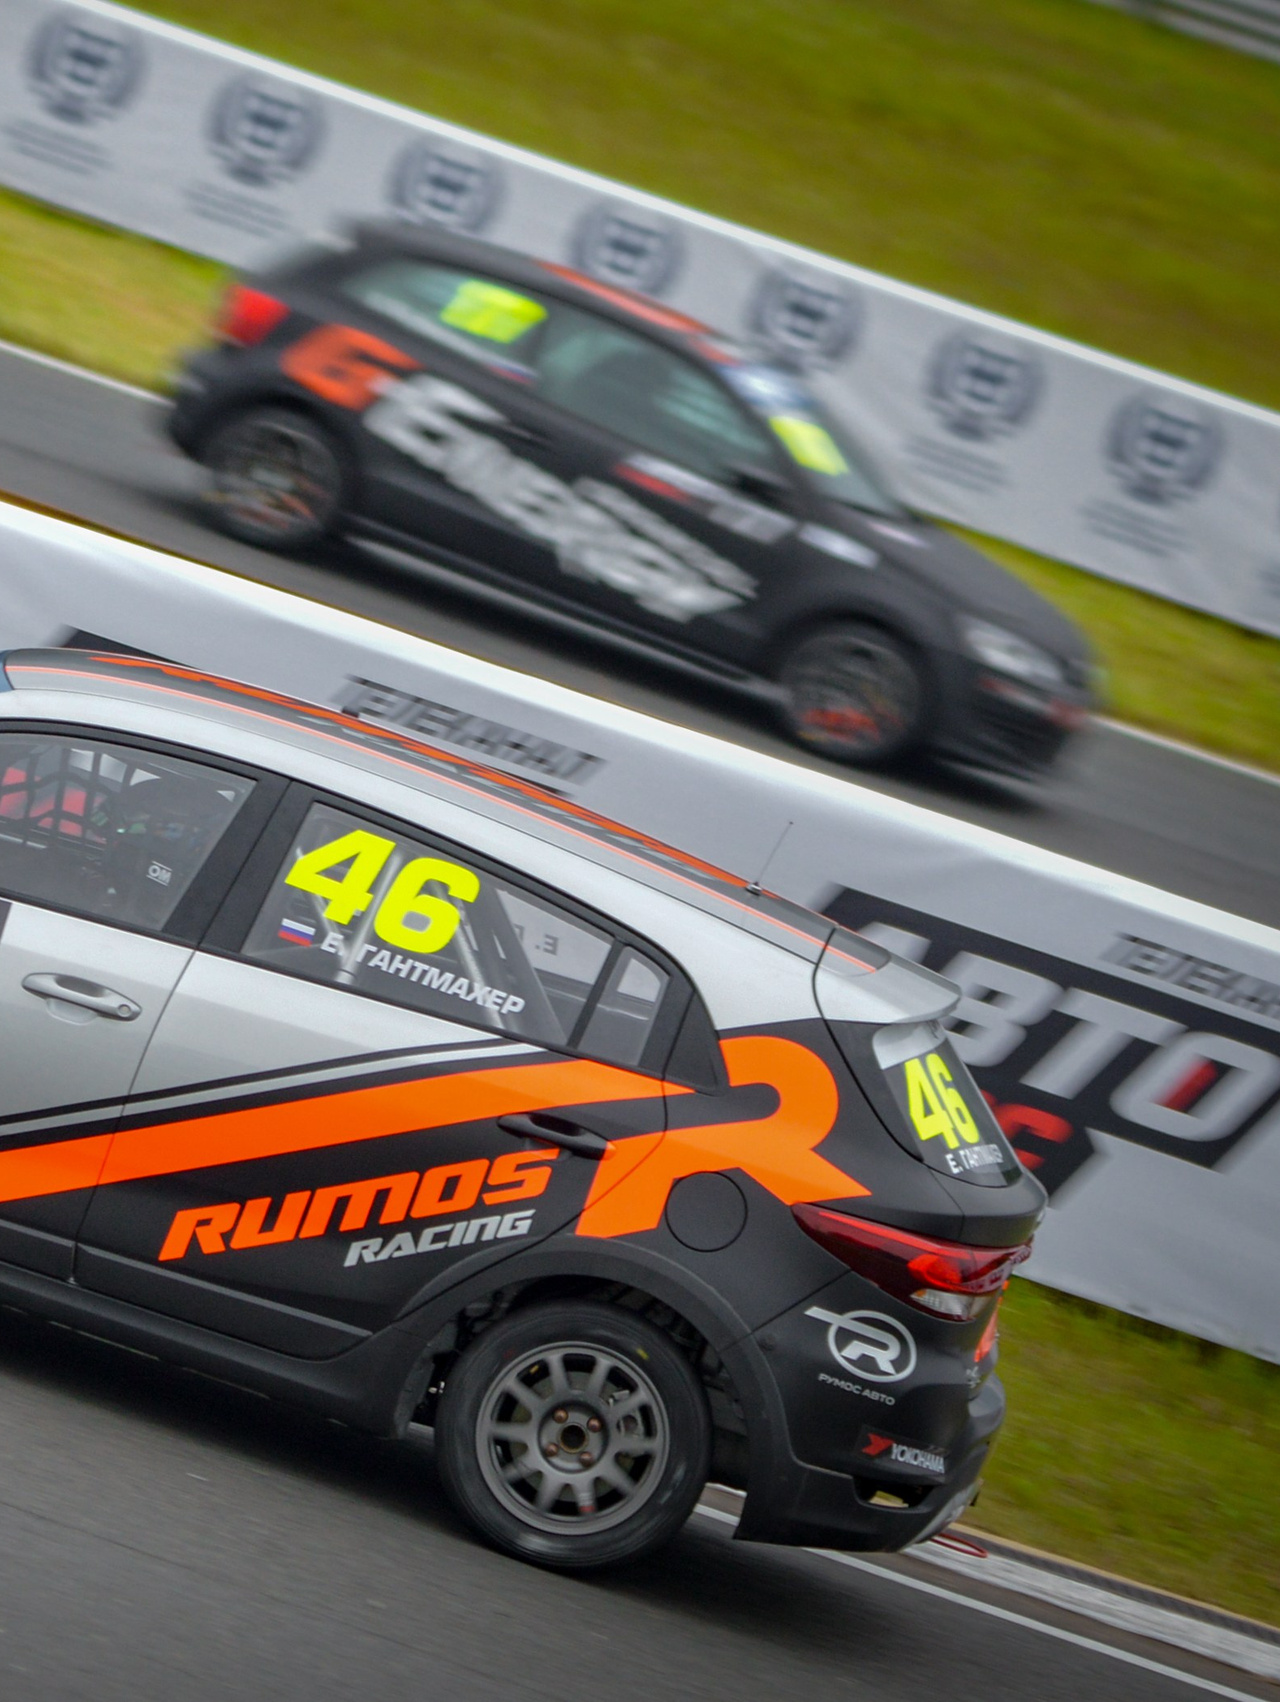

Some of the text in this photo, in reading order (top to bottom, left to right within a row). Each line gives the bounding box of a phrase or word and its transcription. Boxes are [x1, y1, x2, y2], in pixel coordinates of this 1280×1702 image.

[284, 829, 481, 955] 46
[354, 942, 526, 1017] ГАНТМАХЕР
[904, 1053, 980, 1150] 46
[158, 1147, 562, 1261] RUMOS
[344, 1209, 535, 1267] RACING
[818, 1372, 896, 1406] РУМОС АВТО
[890, 1443, 945, 1474] YOKOHAMA
